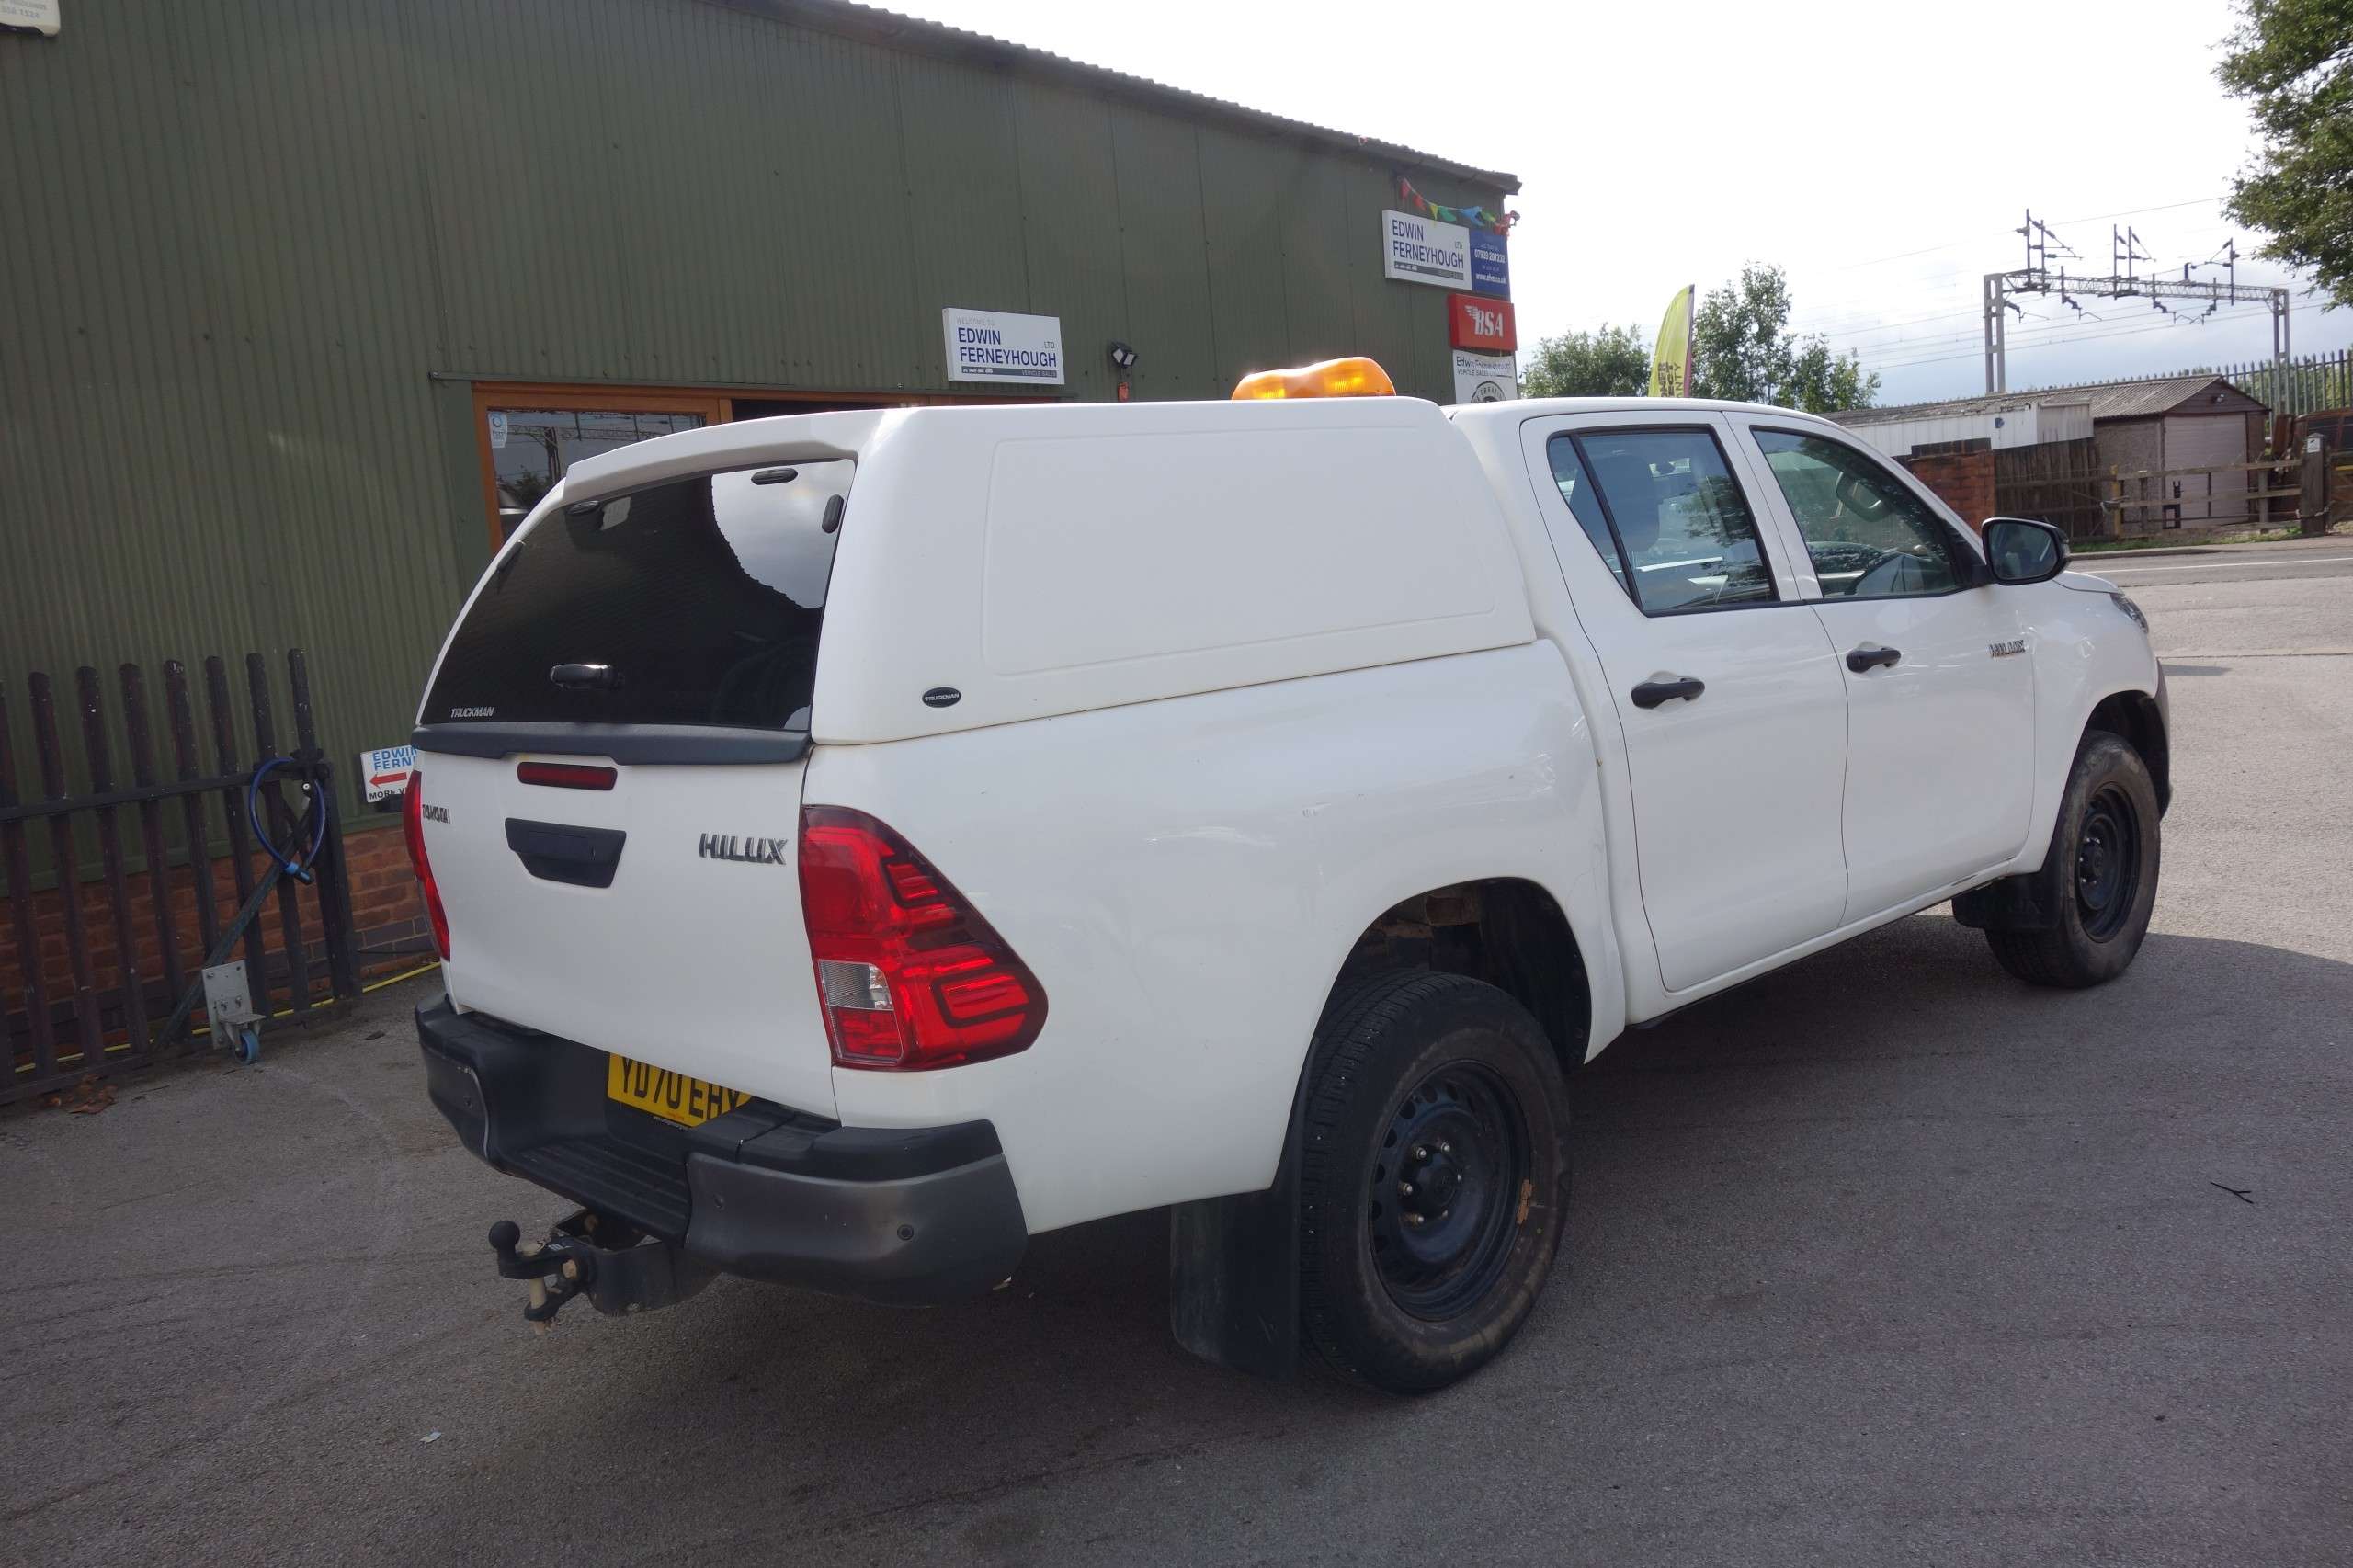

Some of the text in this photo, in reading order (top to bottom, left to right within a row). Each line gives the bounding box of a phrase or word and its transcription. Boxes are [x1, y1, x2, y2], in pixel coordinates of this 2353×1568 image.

[1392, 219, 1424, 241] EDWIN
[1393, 240, 1464, 268] FERNEYHOUGH
[1455, 241, 1463, 250] LTD
[1474, 310, 1504, 337] BSA
[958, 326, 1001, 345] EDWIN
[1044, 341, 1055, 349] LTD
[960, 347, 1057, 368] FERNEYHOUGH
[450, 706, 495, 718] TRUCKMAN
[374, 756, 416, 770] FERN
[423, 804, 450, 824] TOYOTA
[699, 833, 789, 865] HILUX
